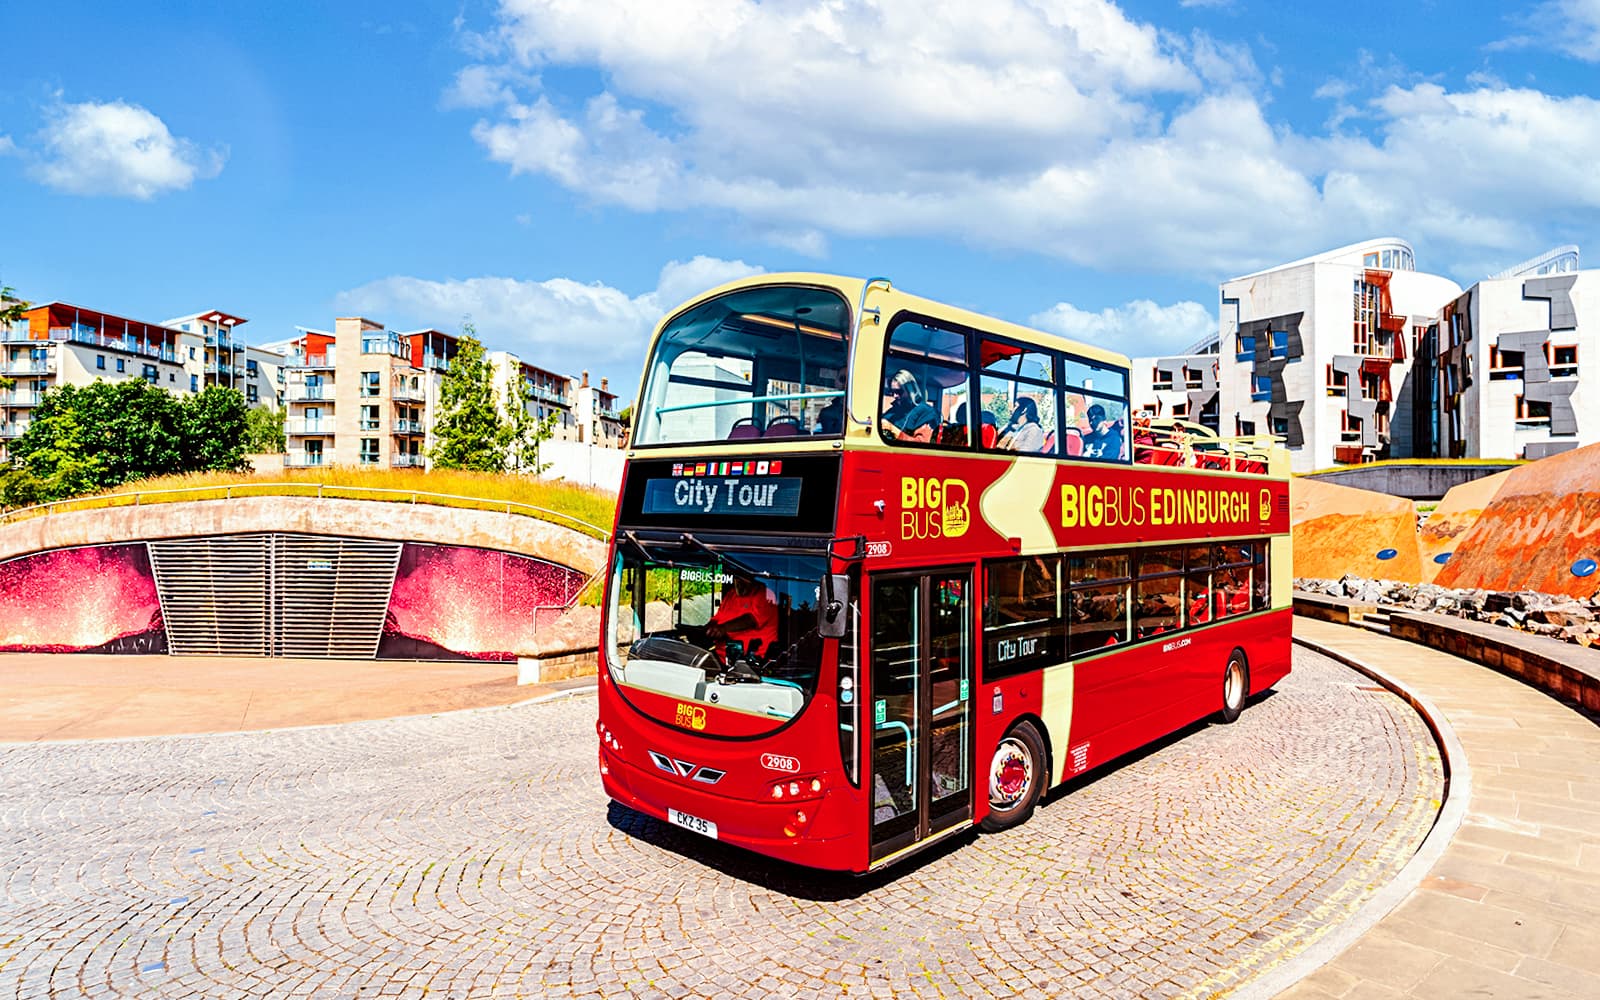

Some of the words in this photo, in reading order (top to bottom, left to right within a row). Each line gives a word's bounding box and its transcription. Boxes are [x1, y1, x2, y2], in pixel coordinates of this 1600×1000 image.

[674, 479, 718, 512] City
[724, 479, 778, 507] Tour
[901, 476, 941, 509] BIG
[1150, 488, 1250, 525] EDINBURGH
[901, 511, 941, 540] BUS
[867, 543, 888, 556] 2908
[680, 569, 734, 585] BIGBUS.COM
[998, 640, 1016, 662] City
[1017, 636, 1038, 657] Tour
[675, 714, 692, 728] BUS
[677, 703, 693, 717] BIG
[767, 756, 793, 770] 2908
[677, 811, 695, 829] CKZ
[695, 819, 708, 834] 35
